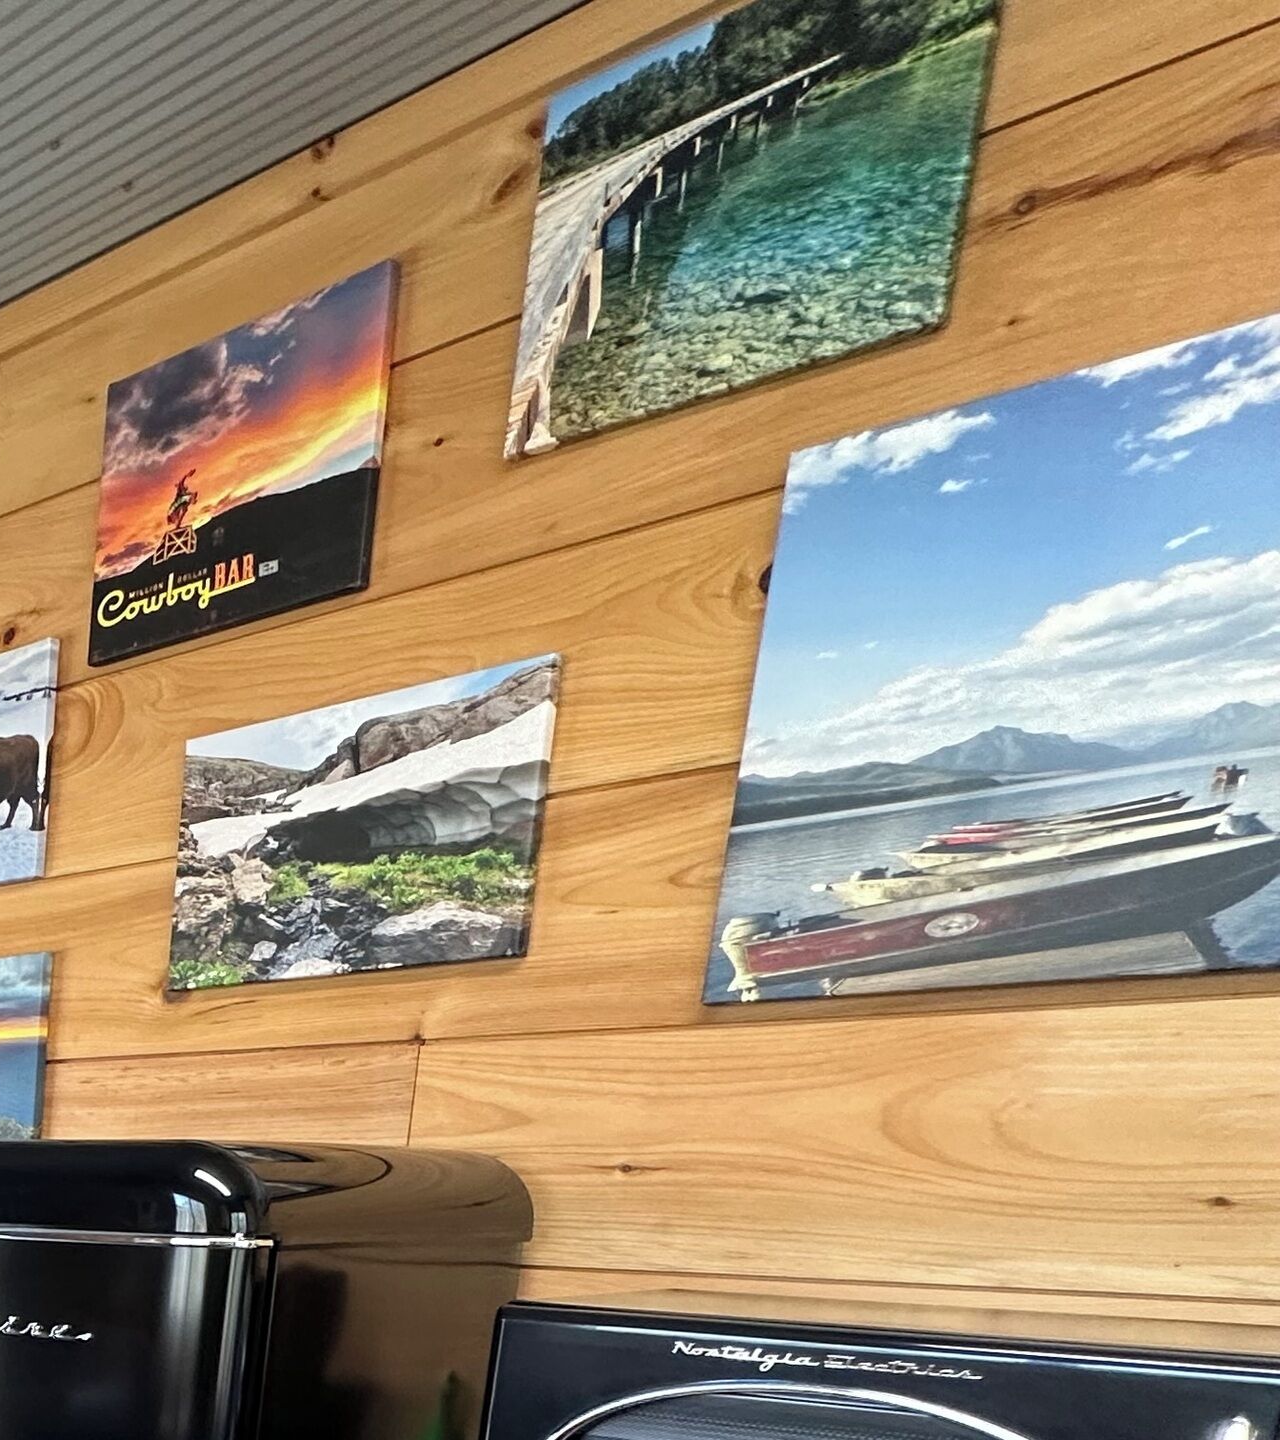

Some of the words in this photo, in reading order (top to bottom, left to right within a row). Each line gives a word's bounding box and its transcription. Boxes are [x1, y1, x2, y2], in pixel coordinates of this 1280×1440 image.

[96, 572, 211, 628] Cowboy
[214, 554, 255, 588] BAR
[671, 1341, 820, 1372] Nostalgia
[823, 1354, 983, 1380] Electrics
